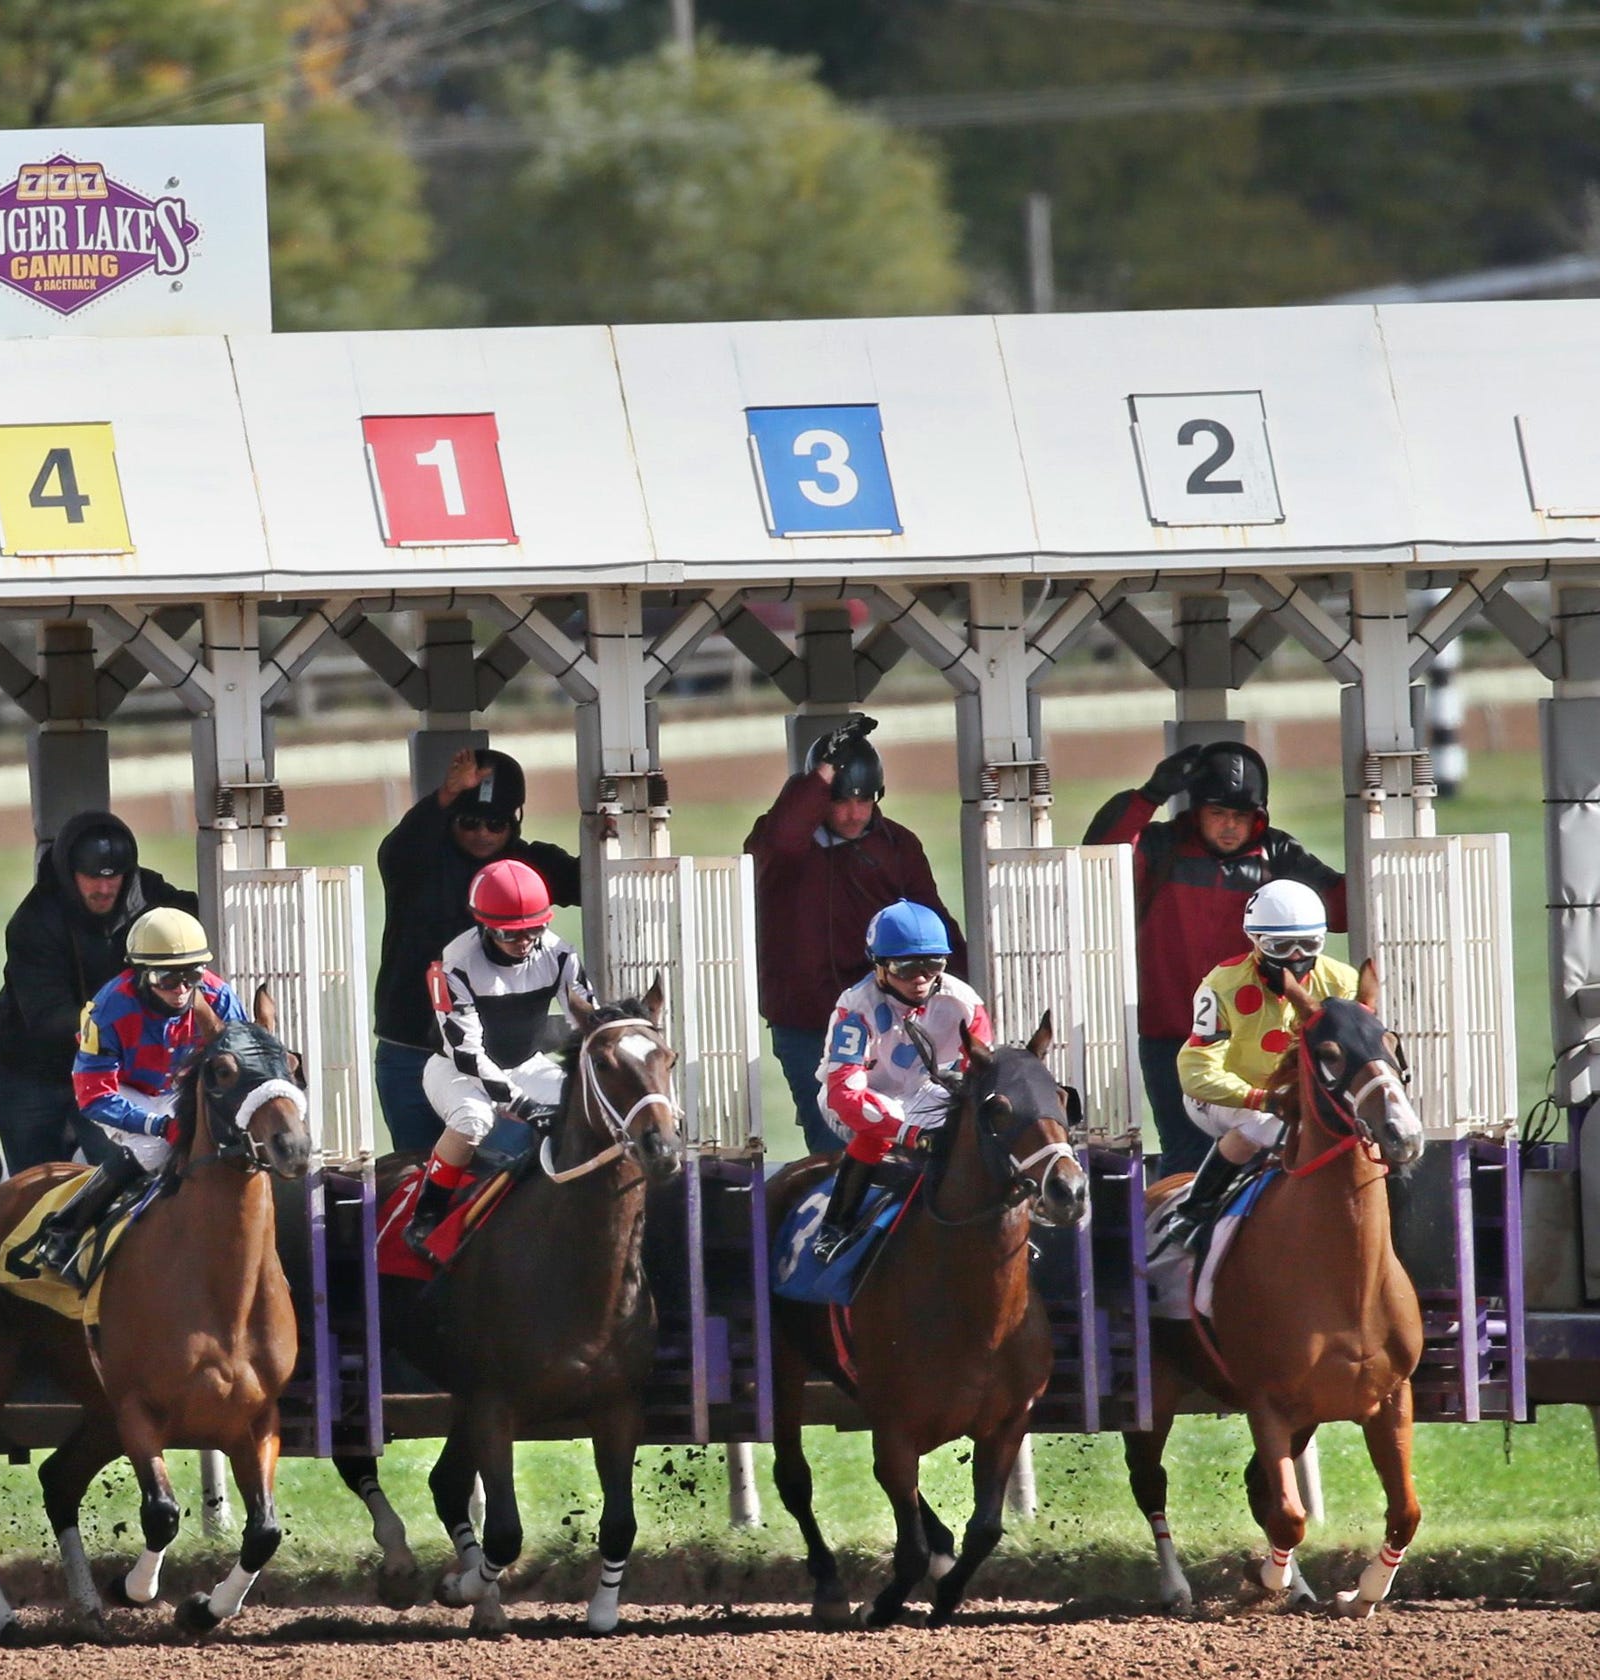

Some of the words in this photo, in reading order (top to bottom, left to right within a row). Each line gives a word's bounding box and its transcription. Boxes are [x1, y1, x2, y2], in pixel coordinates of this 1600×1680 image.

[10, 254, 120, 280] GAMING
[74, 199, 188, 275] LAKES
[34, 280, 42, 292] &
[43, 278, 97, 292] RACETRACK
[27, 448, 92, 525] 4
[412, 438, 468, 518] 1
[791, 428, 859, 508] 3
[1176, 419, 1245, 495] 2
[1246, 893, 1260, 914] 2
[837, 1025, 861, 1056] 3
[1195, 996, 1211, 1026] 2
[778, 1192, 831, 1284] 3
